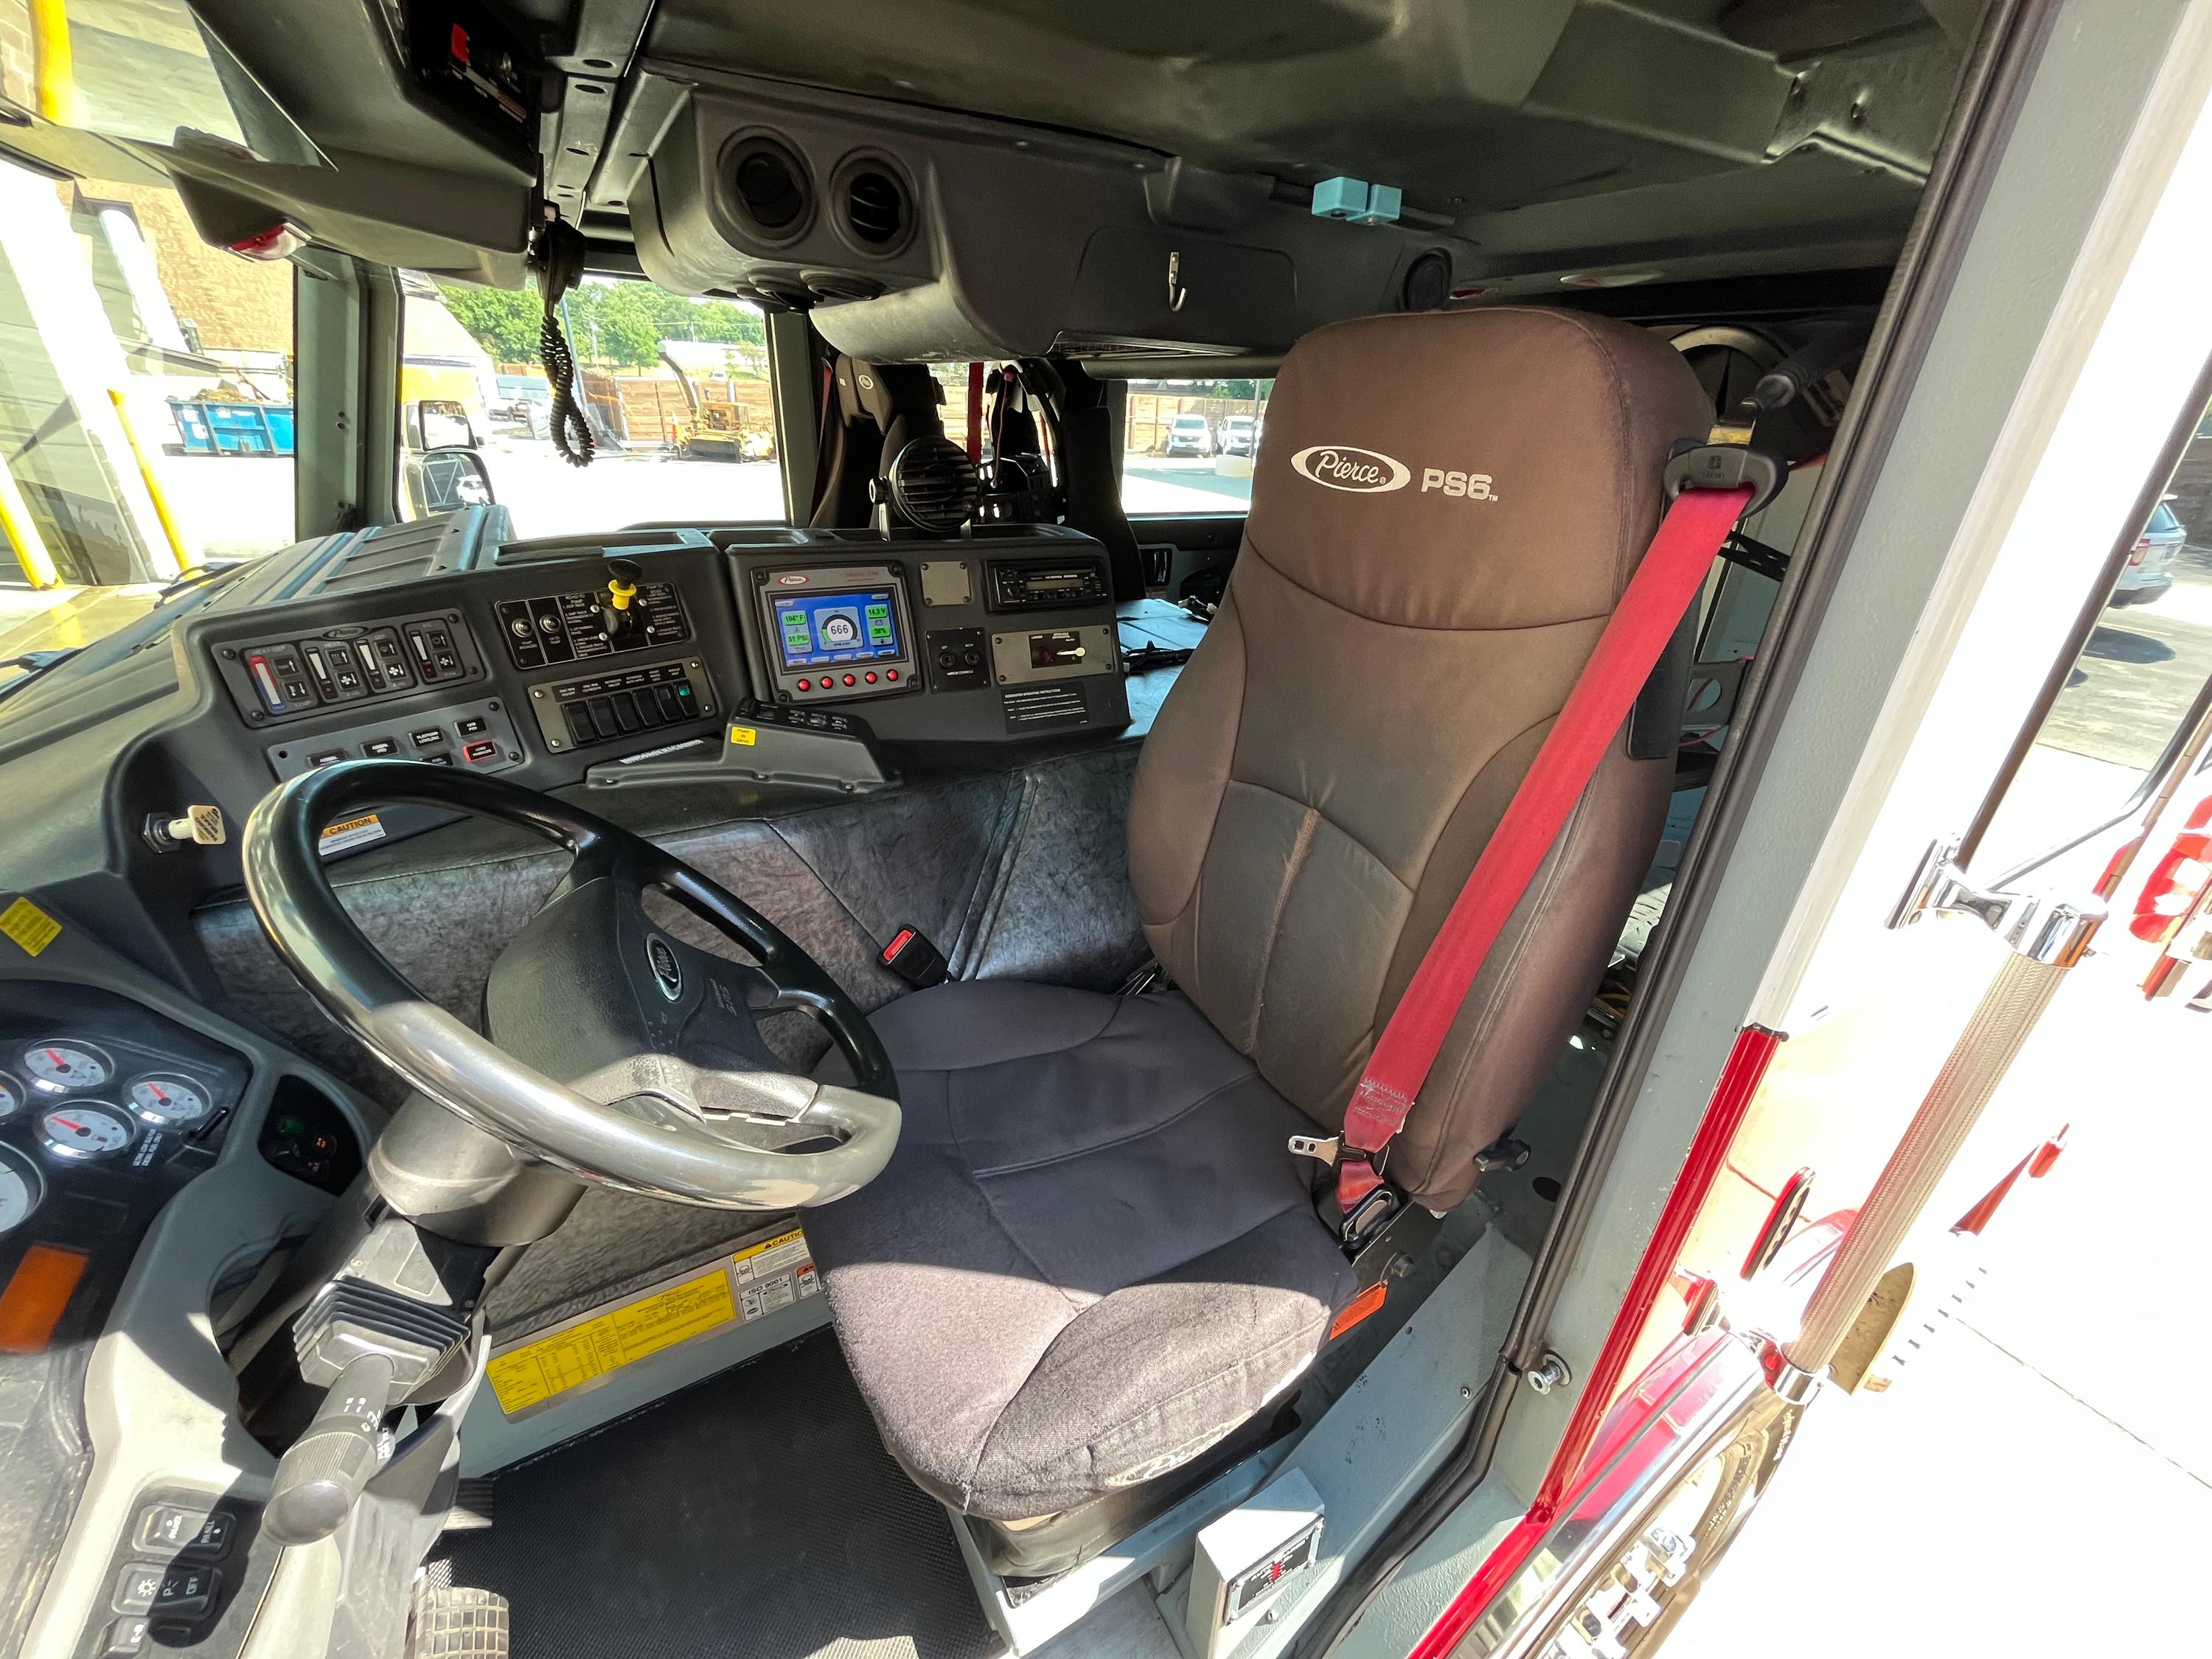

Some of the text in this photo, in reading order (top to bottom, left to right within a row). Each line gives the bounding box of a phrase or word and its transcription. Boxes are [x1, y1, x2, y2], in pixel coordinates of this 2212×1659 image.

[830, 625, 849, 635] 666
[329, 817, 372, 835] CAUTION
[748, 1277, 782, 1295] ISO 9001
